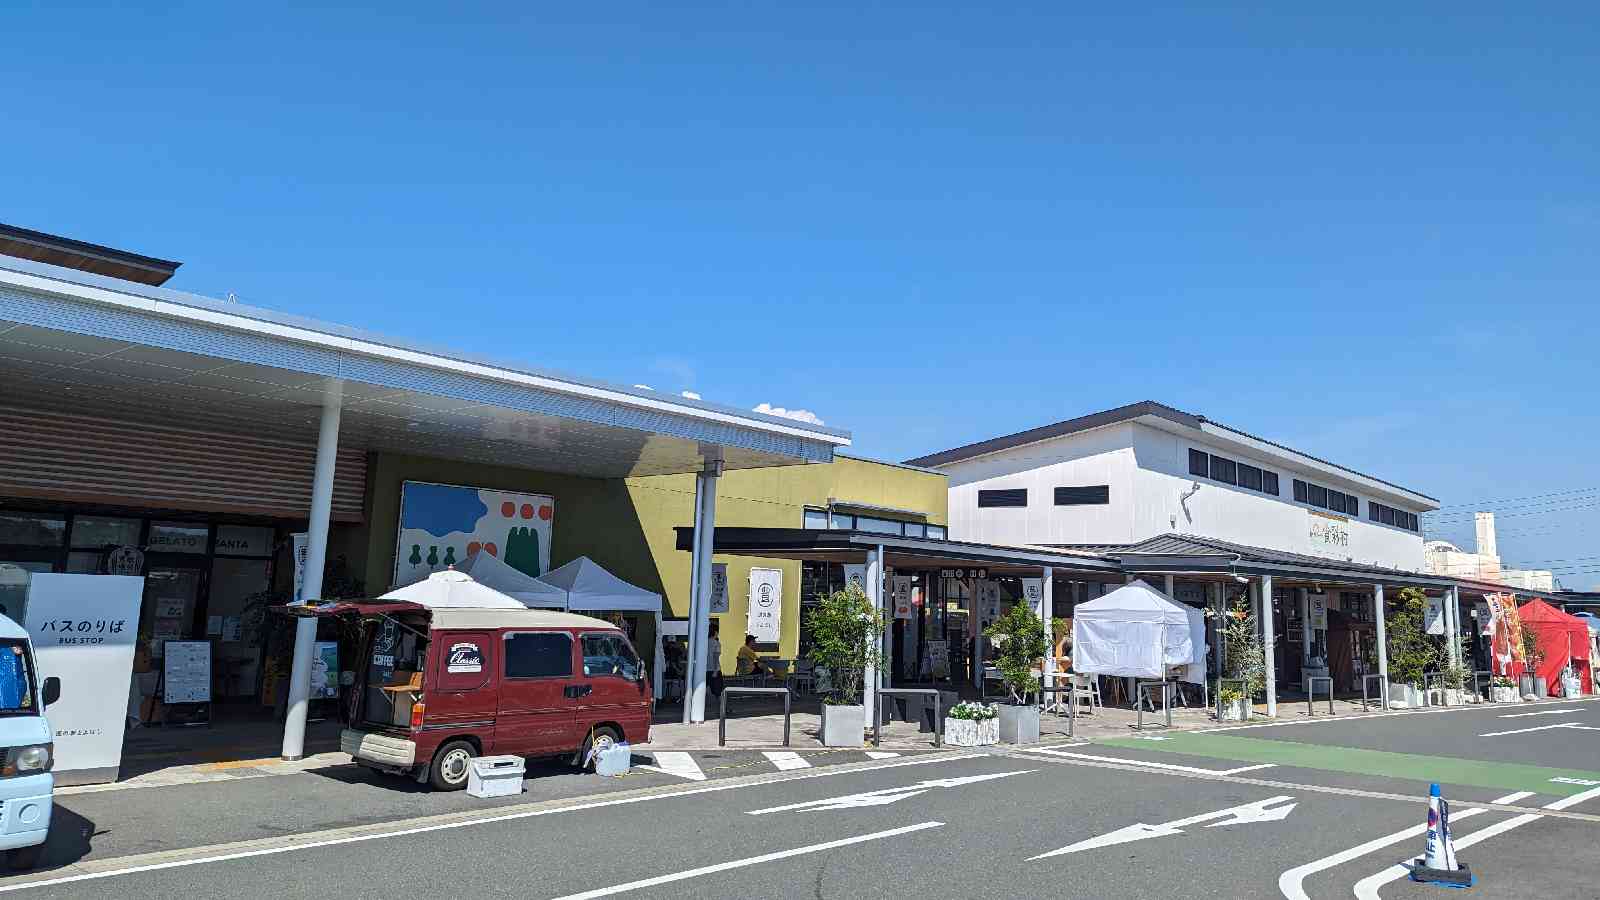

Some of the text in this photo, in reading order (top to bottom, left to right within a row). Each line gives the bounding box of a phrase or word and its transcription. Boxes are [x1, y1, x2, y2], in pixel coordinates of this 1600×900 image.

[41, 619, 125, 633] バスのりば
[79, 637, 104, 645] STOP
